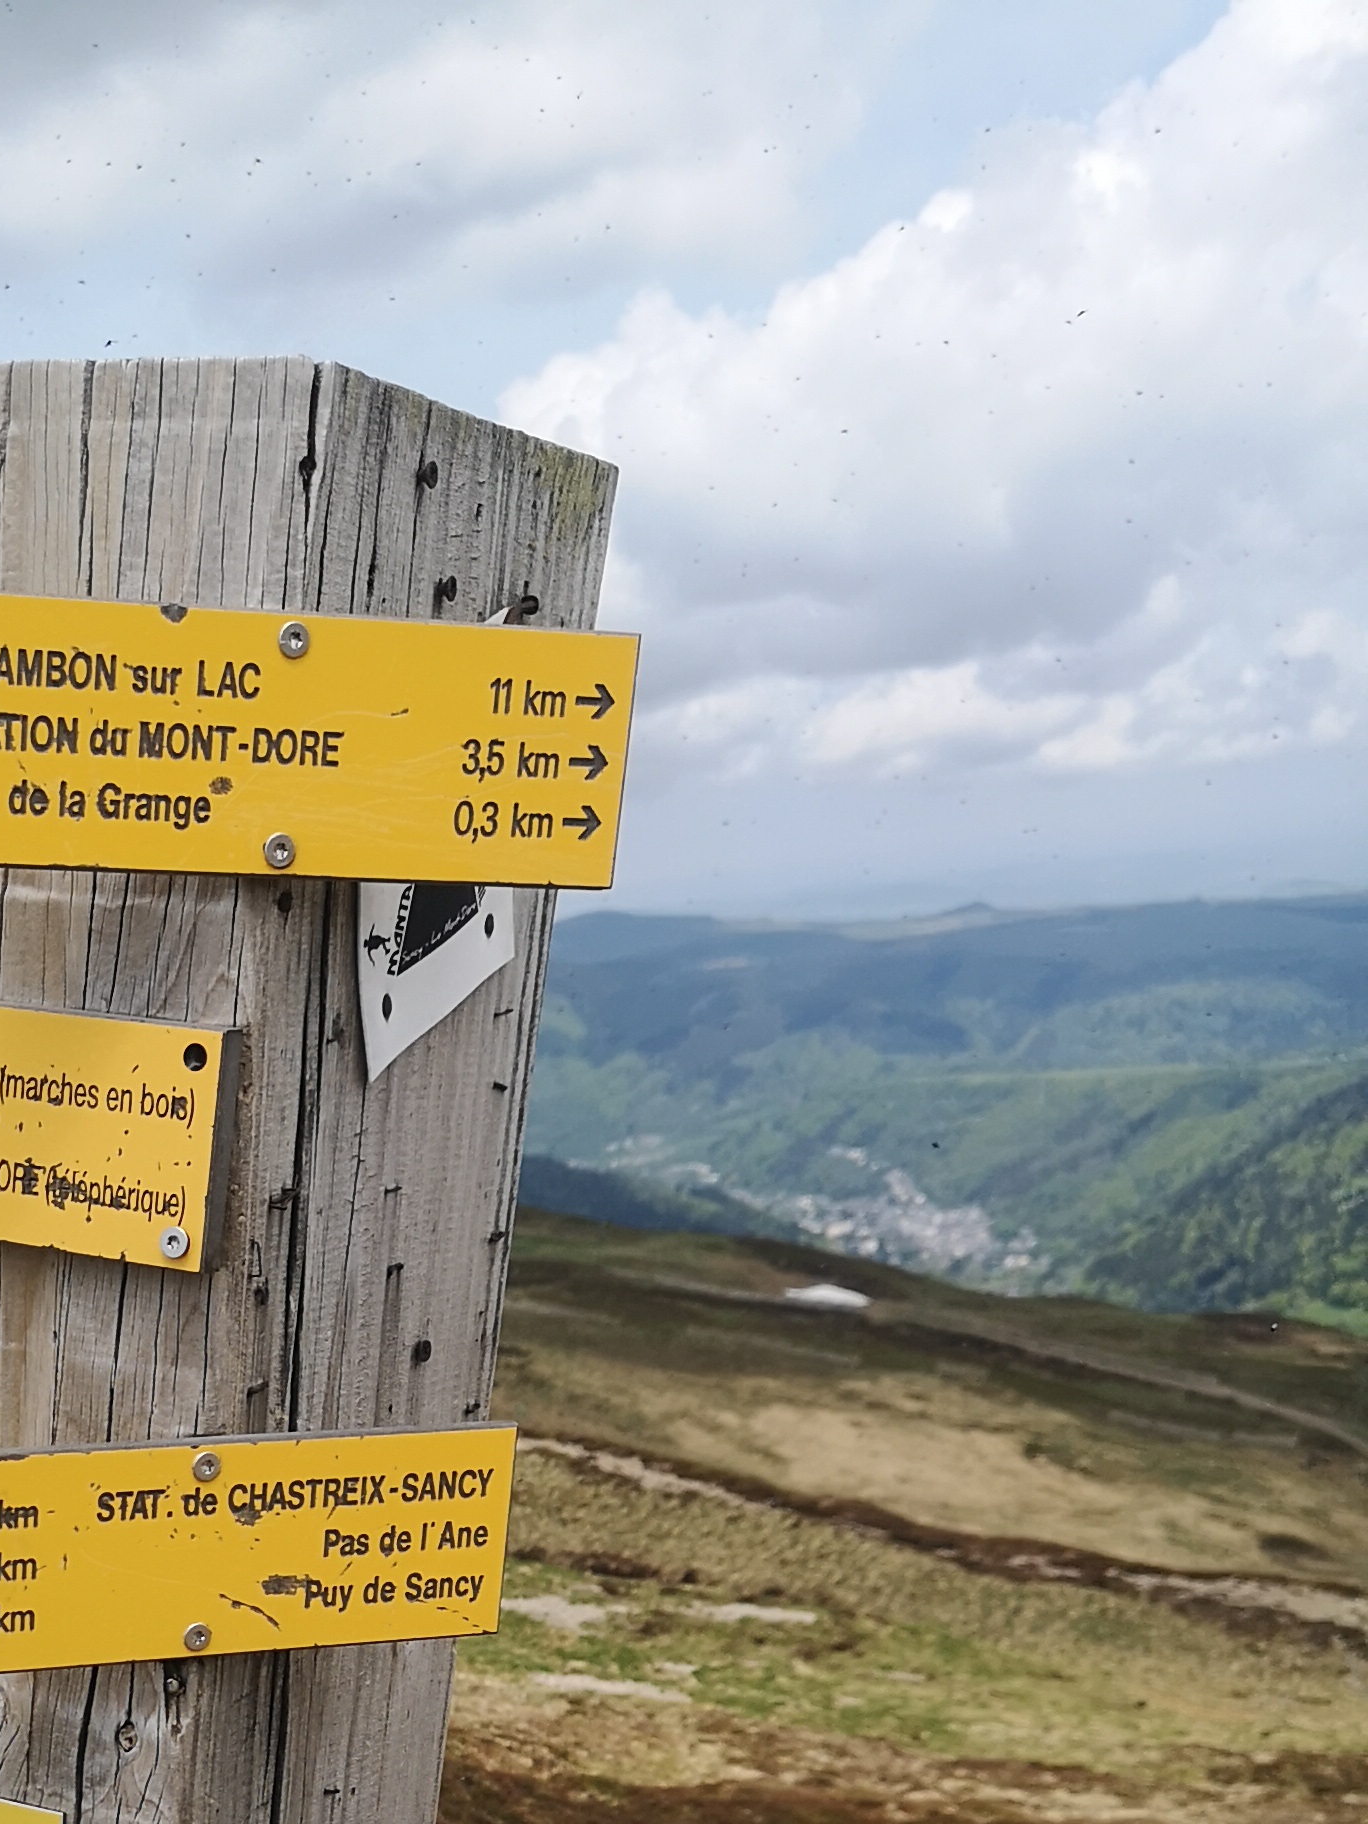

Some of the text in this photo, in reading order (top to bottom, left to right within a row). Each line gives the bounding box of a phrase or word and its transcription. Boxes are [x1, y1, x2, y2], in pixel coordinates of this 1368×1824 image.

[131, 663, 183, 697] sur
[197, 659, 262, 700] LAC
[490, 677, 514, 716] 11
[523, 679, 567, 718] km
[90, 719, 132, 758] du
[138, 721, 344, 769] MONT-DORE
[461, 738, 506, 783] 3,5
[517, 741, 560, 779] km
[8, 780, 50, 817] de
[58, 780, 87, 821] la
[96, 782, 212, 831] Grange
[453, 800, 499, 844] 0,3
[510, 802, 553, 839] km
[0, 1064, 100, 1109] (marches
[106, 1086, 133, 1114] en
[140, 1083, 195, 1130] bois)
[96, 1488, 173, 1523] STAT.
[181, 1486, 218, 1518] de
[228, 1468, 495, 1514] CHASTREIX-SANCY
[322, 1529, 369, 1558] Pas
[379, 1524, 412, 1555] de
[304, 1578, 354, 1613] Puy
[362, 1575, 397, 1605] de
[405, 1572, 485, 1603] Sancy
